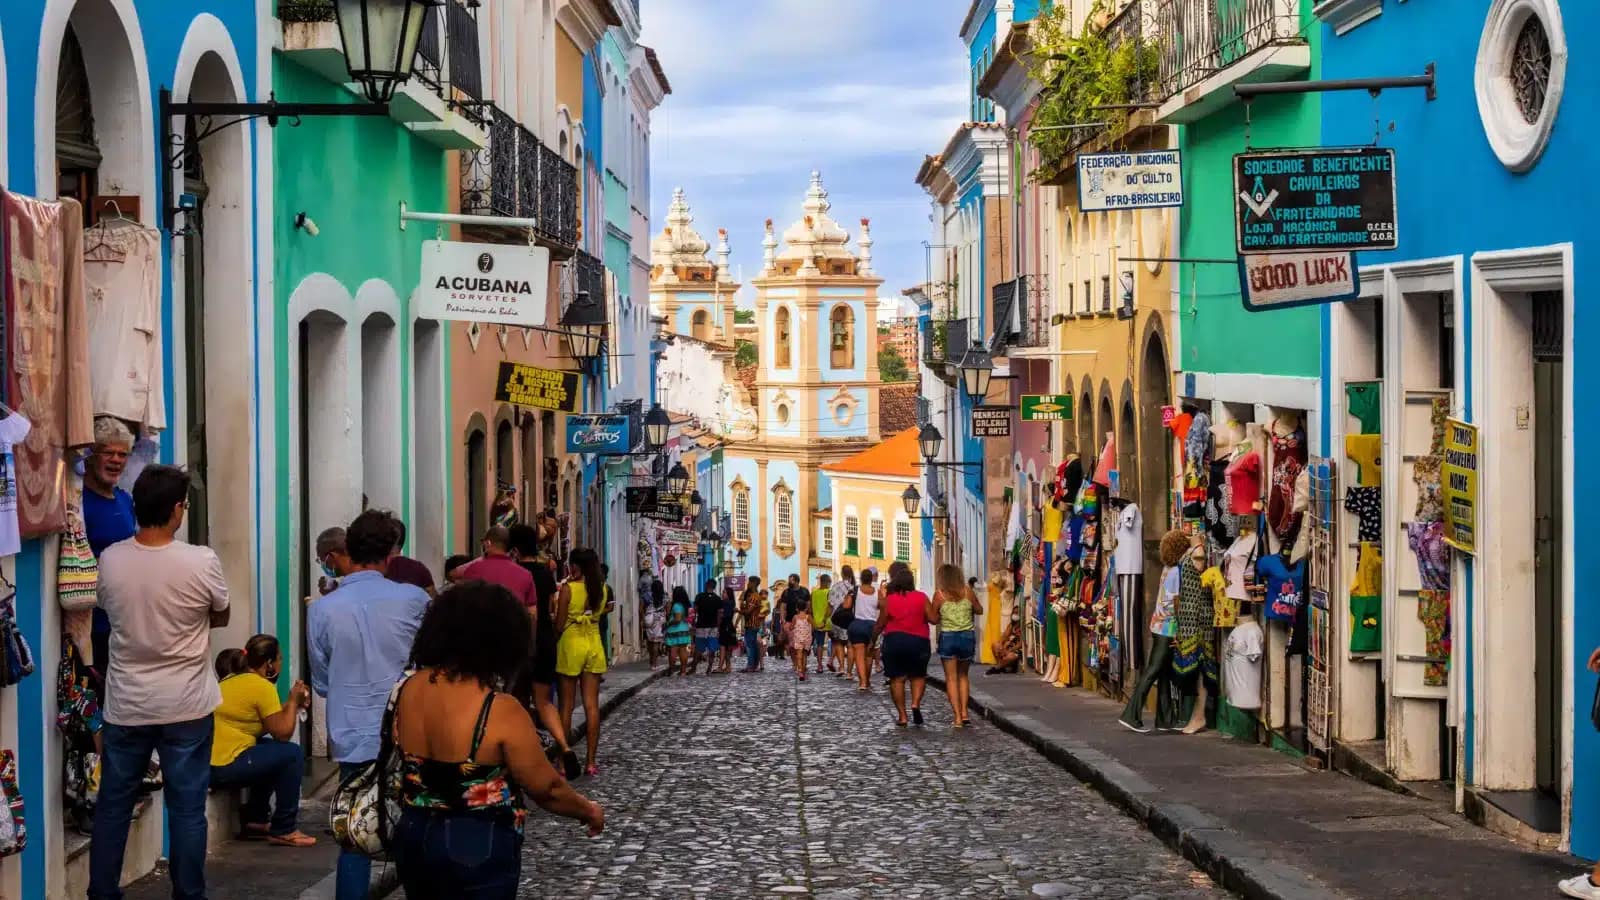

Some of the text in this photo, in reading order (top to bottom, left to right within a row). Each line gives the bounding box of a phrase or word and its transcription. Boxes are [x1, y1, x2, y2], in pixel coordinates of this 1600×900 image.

[1081, 154, 1178, 169] FEDERAÇÃO NACIONAL
[1244, 156, 1390, 175] SOCIEDADE BENEFICENTE
[1127, 172, 1172, 184] DO CULTO
[1289, 175, 1361, 191] CAVALEIROS
[1105, 193, 1181, 206] AFRO-BRASILEIRO
[1315, 192, 1332, 205] DA
[1275, 206, 1362, 221] FRATERNIDADE
[1245, 224, 1274, 234] LOJA
[1289, 231, 1369, 244] FRATERNIDADE
[1251, 256, 1348, 292] GOOD LUCK
[451, 293, 517, 303] SORVETES
[1453, 427, 1473, 448] TEMOS
[1449, 472, 1468, 492] NOME
